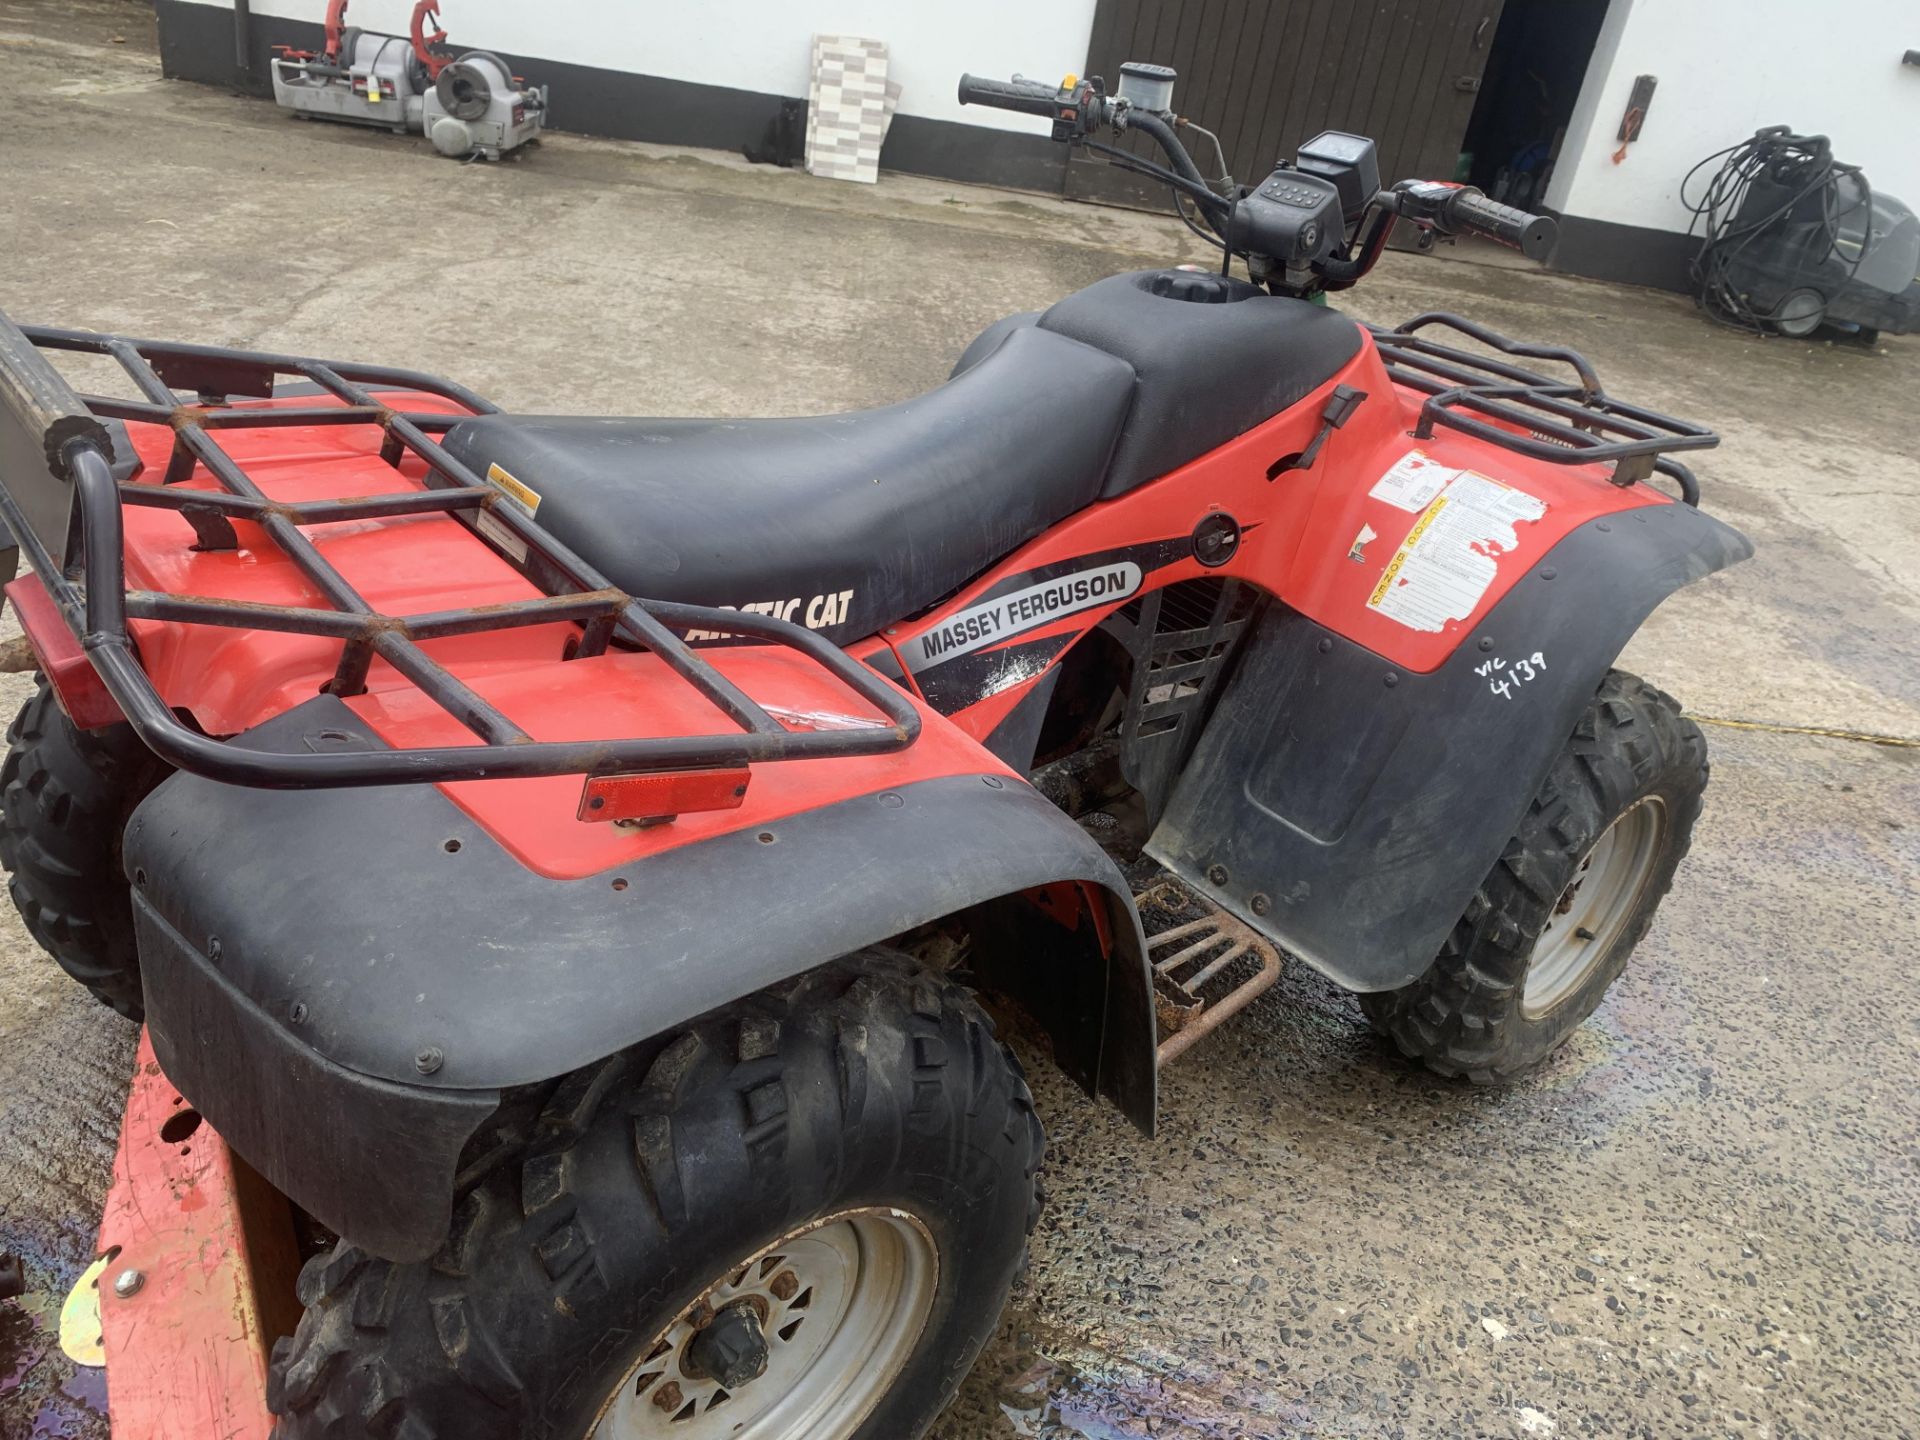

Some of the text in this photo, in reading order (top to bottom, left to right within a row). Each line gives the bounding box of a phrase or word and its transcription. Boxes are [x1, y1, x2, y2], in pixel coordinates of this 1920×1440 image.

[804, 589, 854, 630] CAT
[921, 569, 1136, 660] MASSEY FERGUSON
[1489, 651, 1547, 700] 4139
